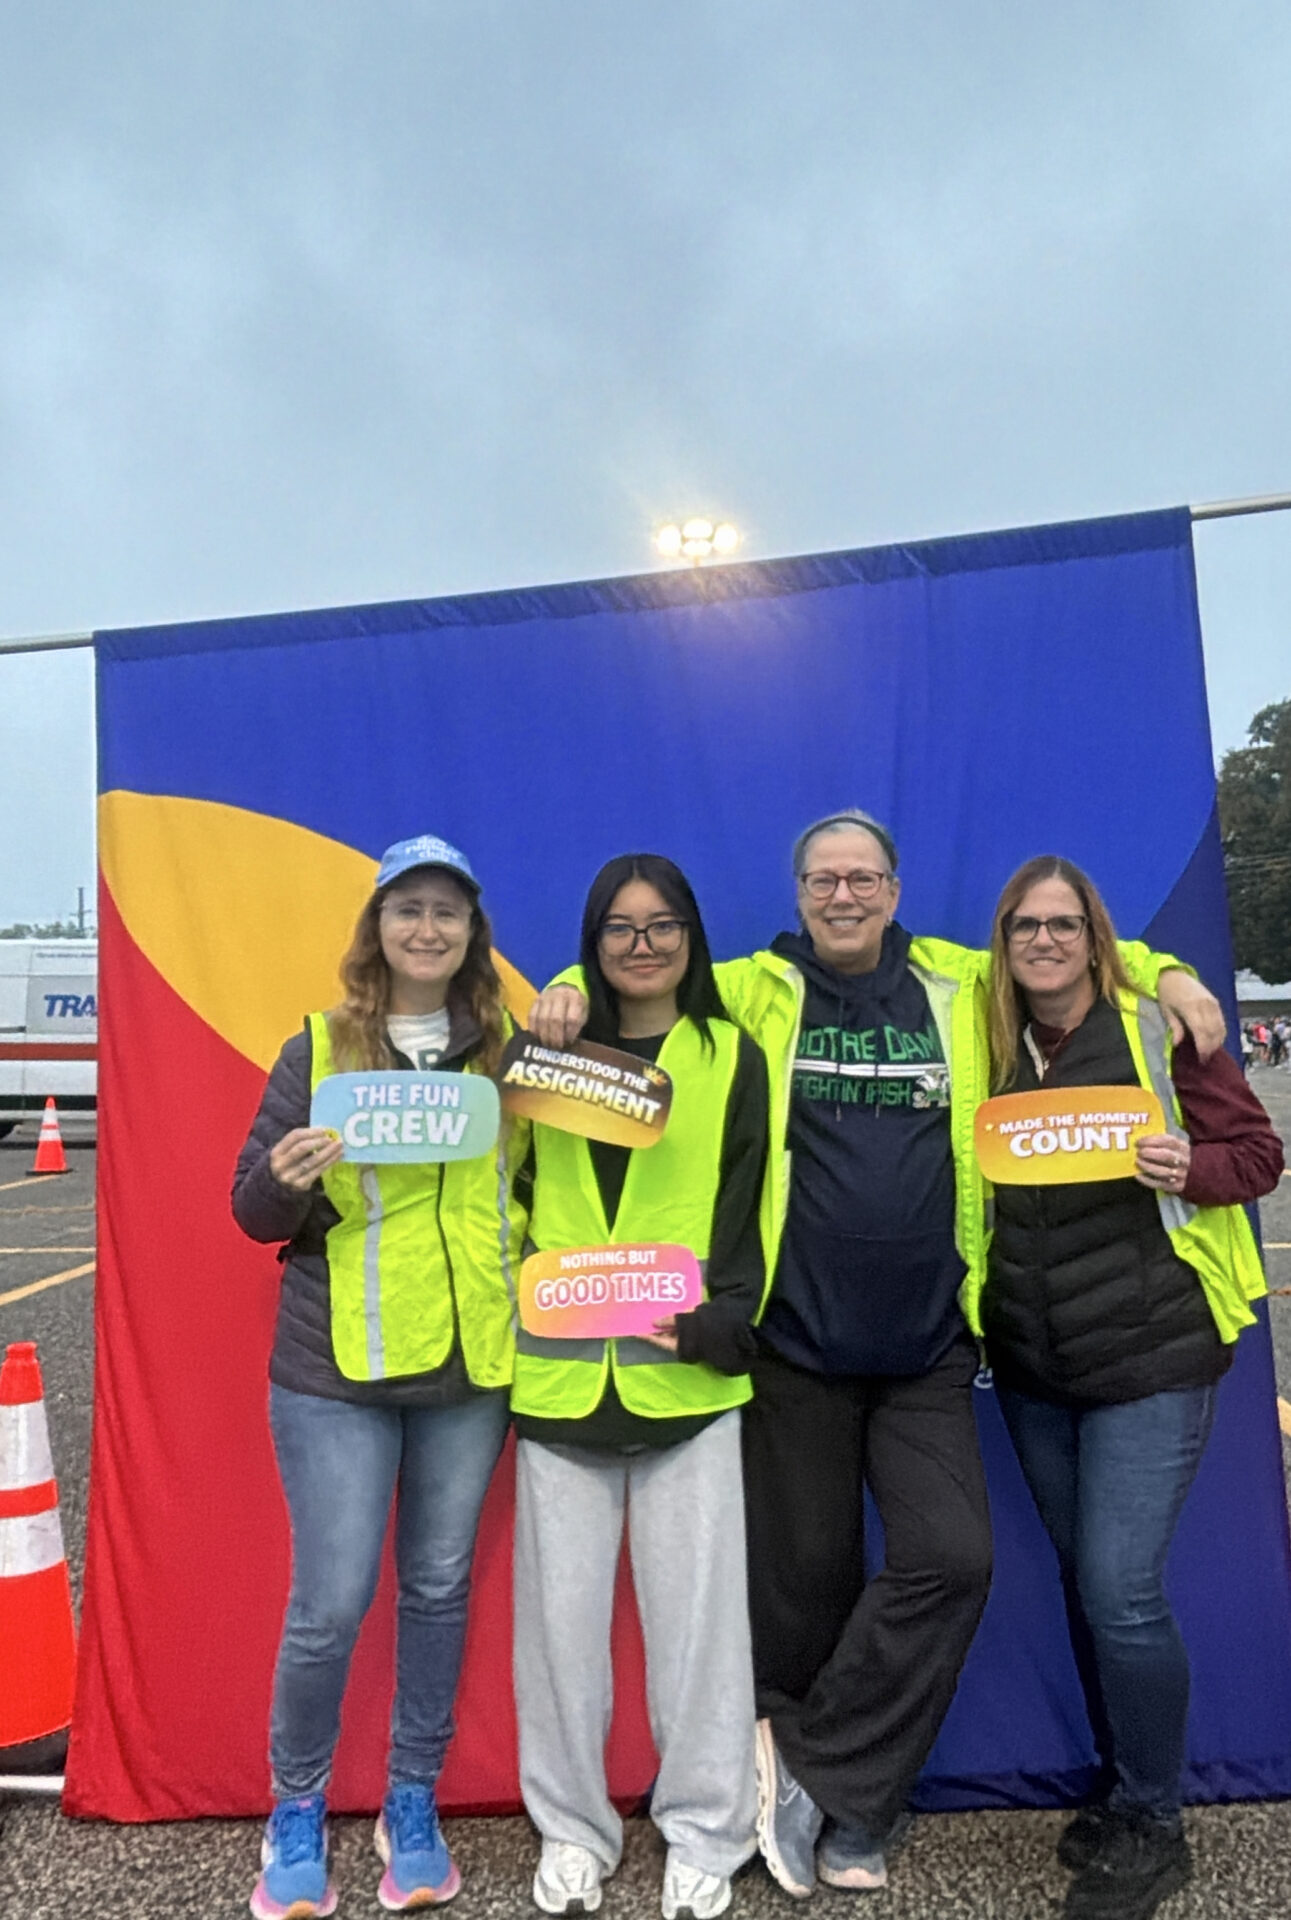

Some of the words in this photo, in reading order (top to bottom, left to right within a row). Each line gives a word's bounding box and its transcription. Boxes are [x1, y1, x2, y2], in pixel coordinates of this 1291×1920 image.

[44, 994, 98, 1018] TRA
[884, 1025, 943, 1060] DAM
[523, 1044, 532, 1058] I
[532, 1046, 622, 1081] UNDERSTOOD
[623, 1071, 650, 1092] THE
[352, 1084, 401, 1107] THE
[409, 1084, 460, 1107] FUN
[503, 1060, 662, 1124] ASSIGNMENT
[343, 1110, 469, 1148] CREW
[1000, 1117, 1043, 1134] MADE
[1047, 1113, 1075, 1127] THE
[1079, 1112, 1149, 1126] MOMENT
[1009, 1126, 1132, 1158] COUNT
[560, 1251, 625, 1269] NOTHING
[628, 1250, 658, 1265] BUT
[535, 1274, 609, 1310] GOOD
[610, 1272, 687, 1303] TIMES
